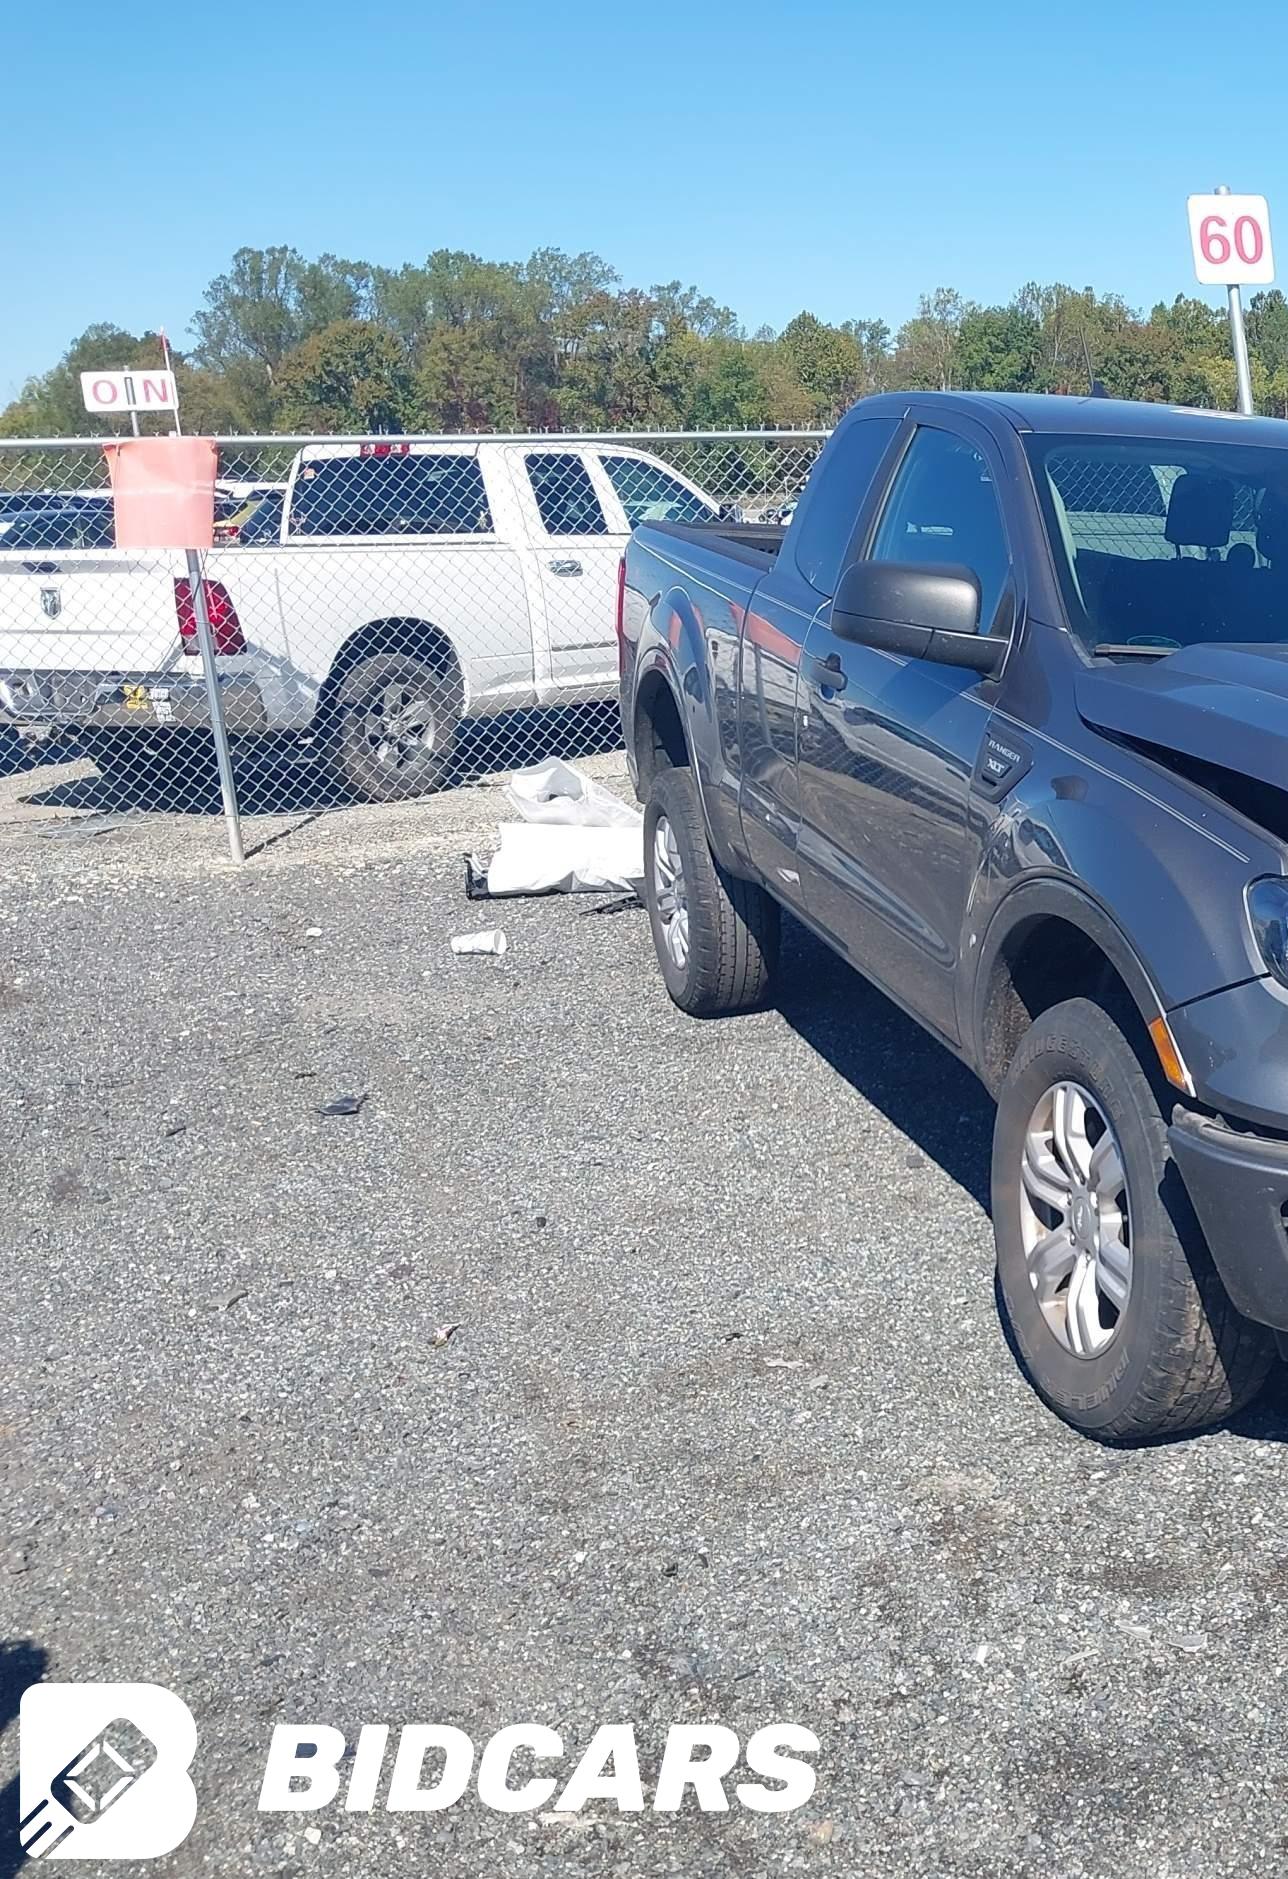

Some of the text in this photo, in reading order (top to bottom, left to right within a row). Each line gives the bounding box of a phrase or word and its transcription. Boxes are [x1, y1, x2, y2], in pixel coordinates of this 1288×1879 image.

[1200, 215, 1263, 264] 60
[988, 739, 1020, 763] RANGER
[987, 758, 1005, 773] XLT
